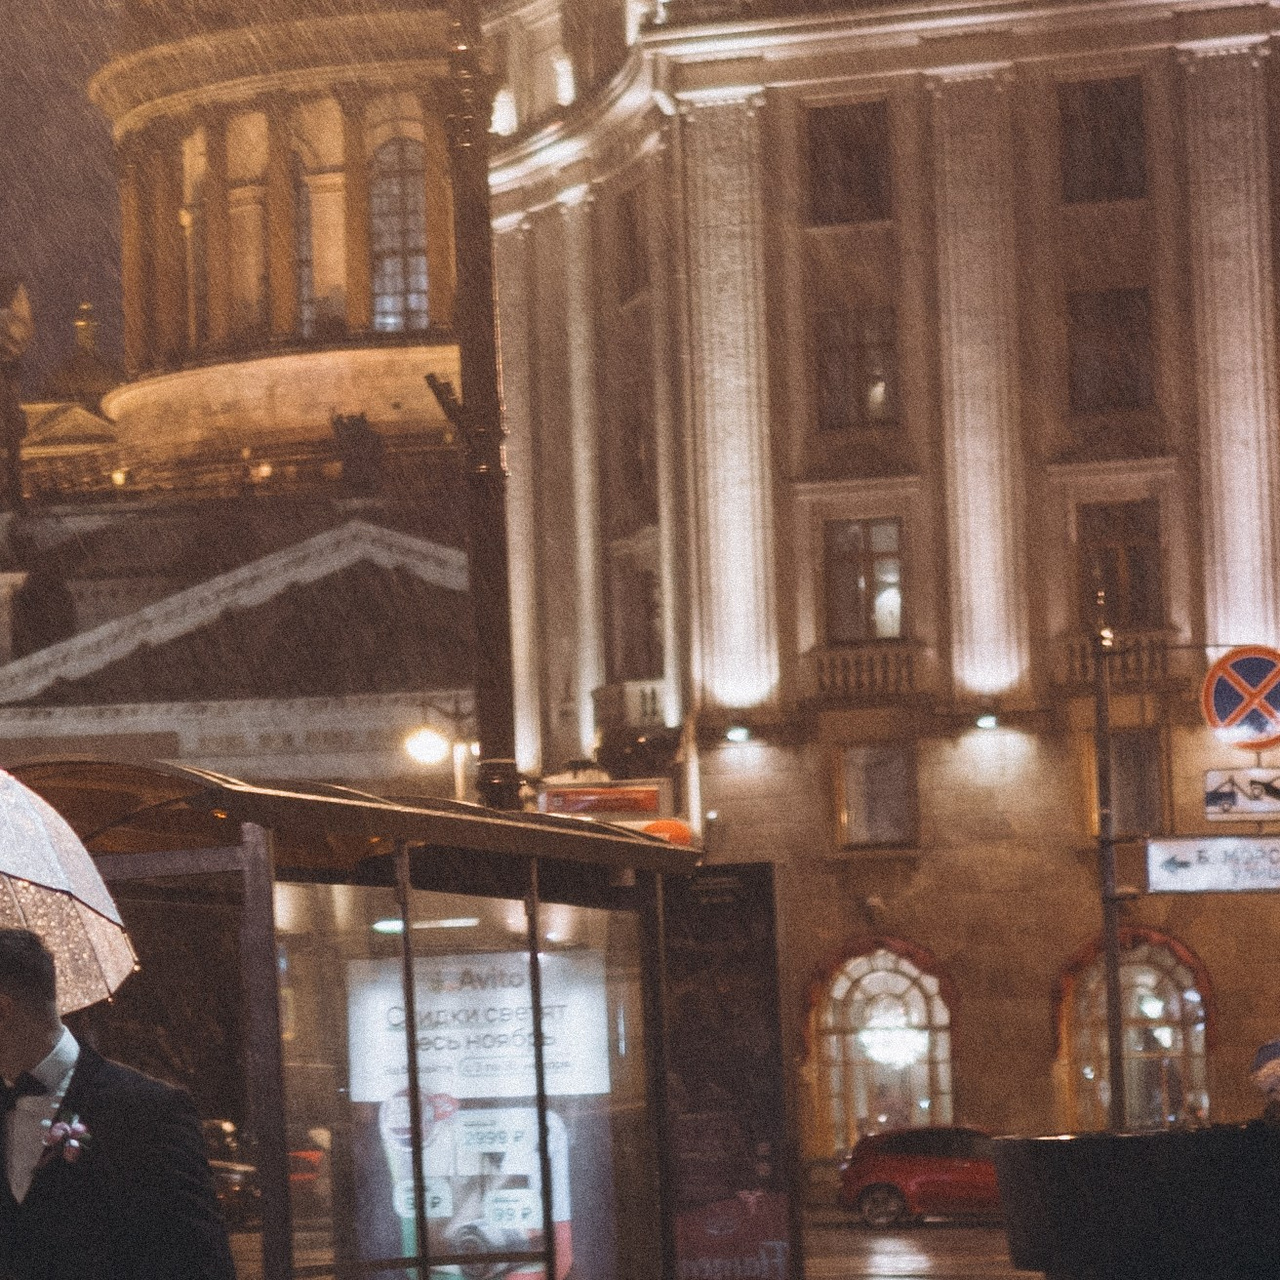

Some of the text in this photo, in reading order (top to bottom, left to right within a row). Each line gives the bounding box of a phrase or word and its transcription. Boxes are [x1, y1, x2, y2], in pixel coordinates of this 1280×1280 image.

[459, 966, 524, 989] Avito
[387, 1004, 567, 1027] Сидки свеят
[406, 1034, 461, 1051] есь
